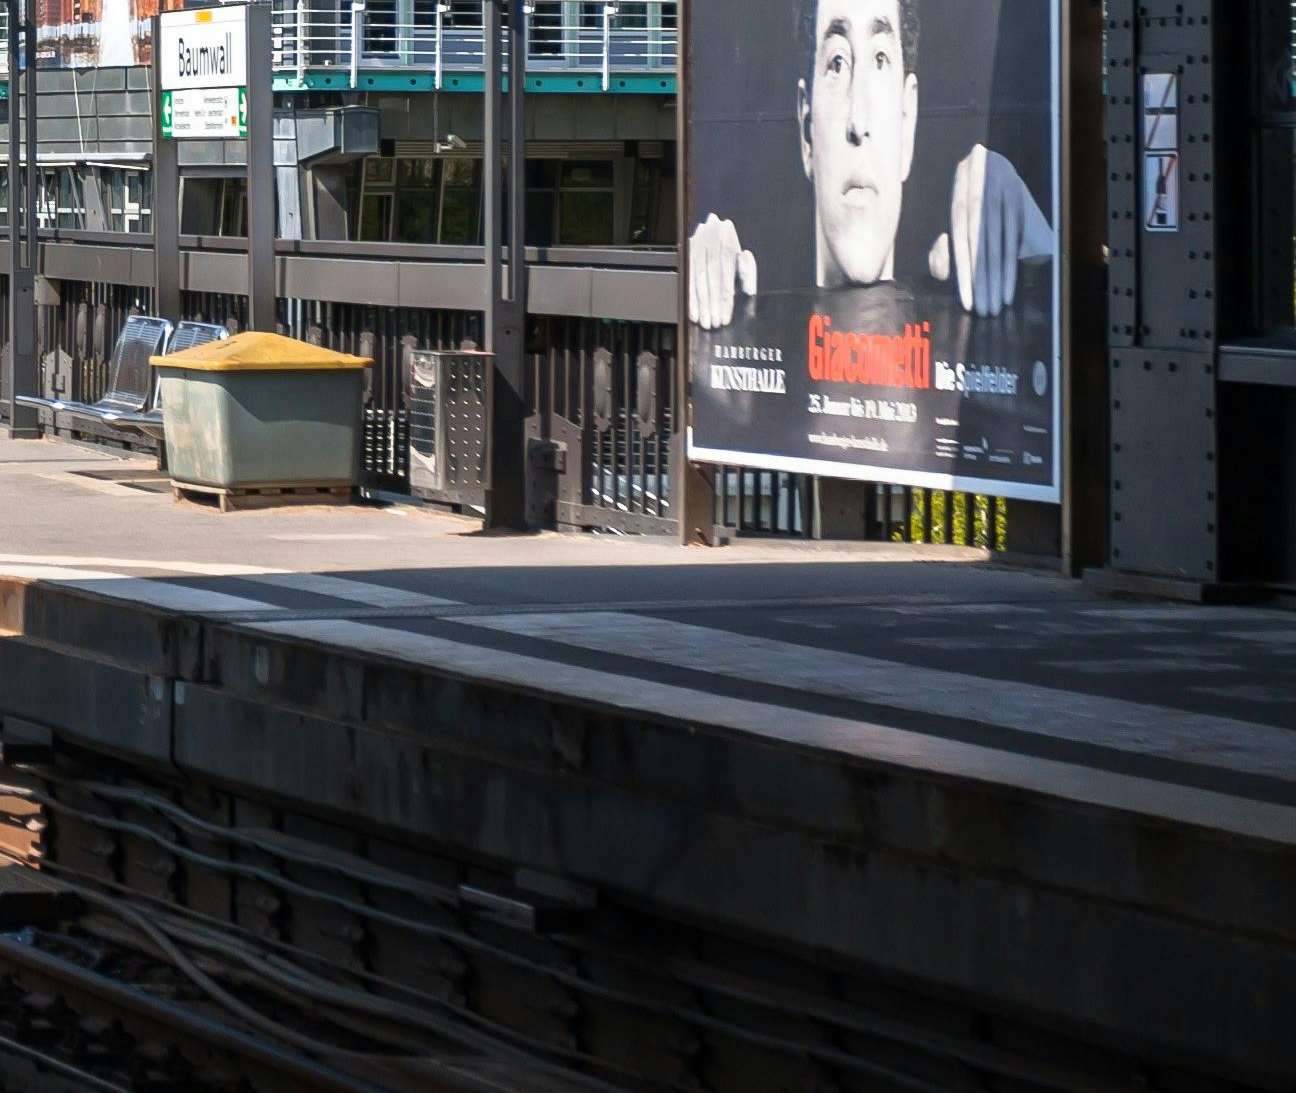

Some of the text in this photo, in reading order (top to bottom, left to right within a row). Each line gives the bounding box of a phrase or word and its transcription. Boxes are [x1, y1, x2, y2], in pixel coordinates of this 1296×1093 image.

[178, 32, 232, 78] Baumwall
[714, 344, 784, 363] HAMBURGER
[808, 313, 931, 390] Giacometti
[710, 364, 787, 395] KUNSTHALLE
[934, 361, 956, 392] Die
